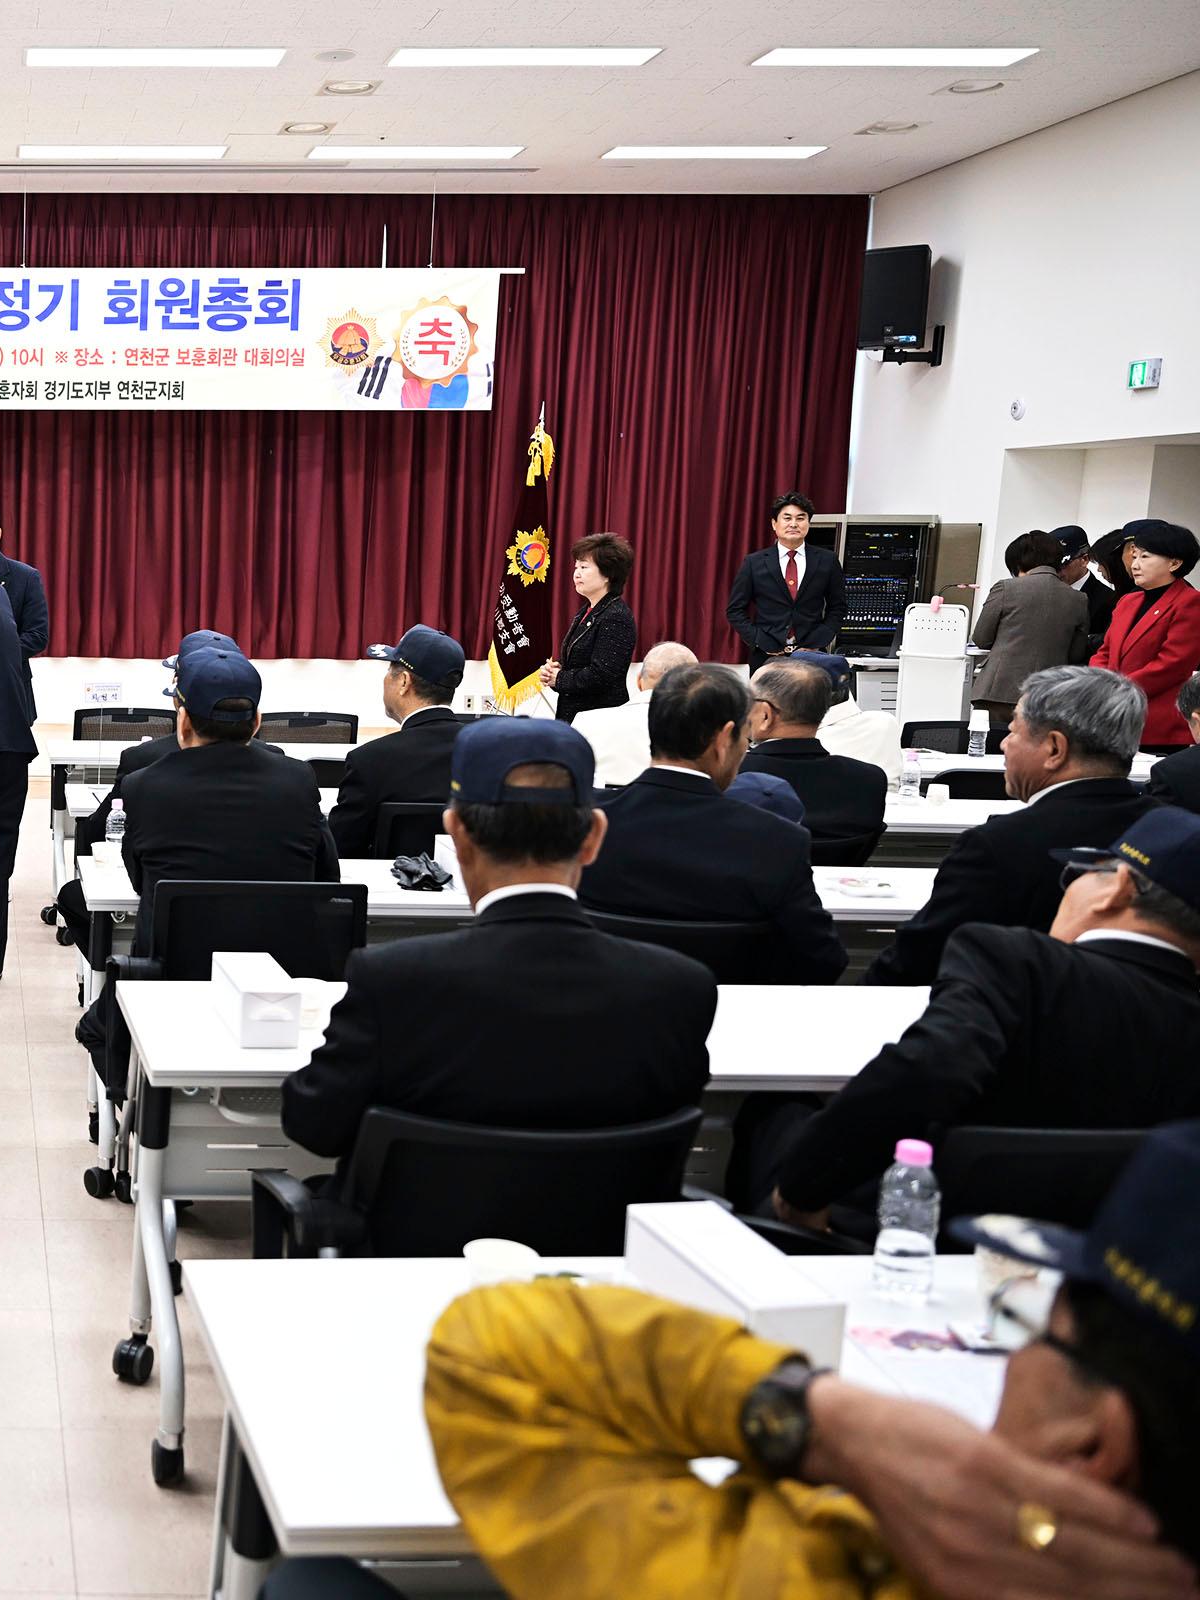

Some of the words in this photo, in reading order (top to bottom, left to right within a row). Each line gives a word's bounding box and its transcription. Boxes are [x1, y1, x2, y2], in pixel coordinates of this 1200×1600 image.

[103, 277, 301, 333] 회원총회
[11, 347, 44, 367] 10시
[73, 347, 105, 367] 장소
[124, 347, 170, 367] 연천군
[176, 347, 238, 367] 보훈회관
[244, 347, 305, 367] 대회의실
[414, 317, 456, 366] 축
[43, 380, 112, 401] 경기도지부
[116, 380, 185, 401] 연천군지회
